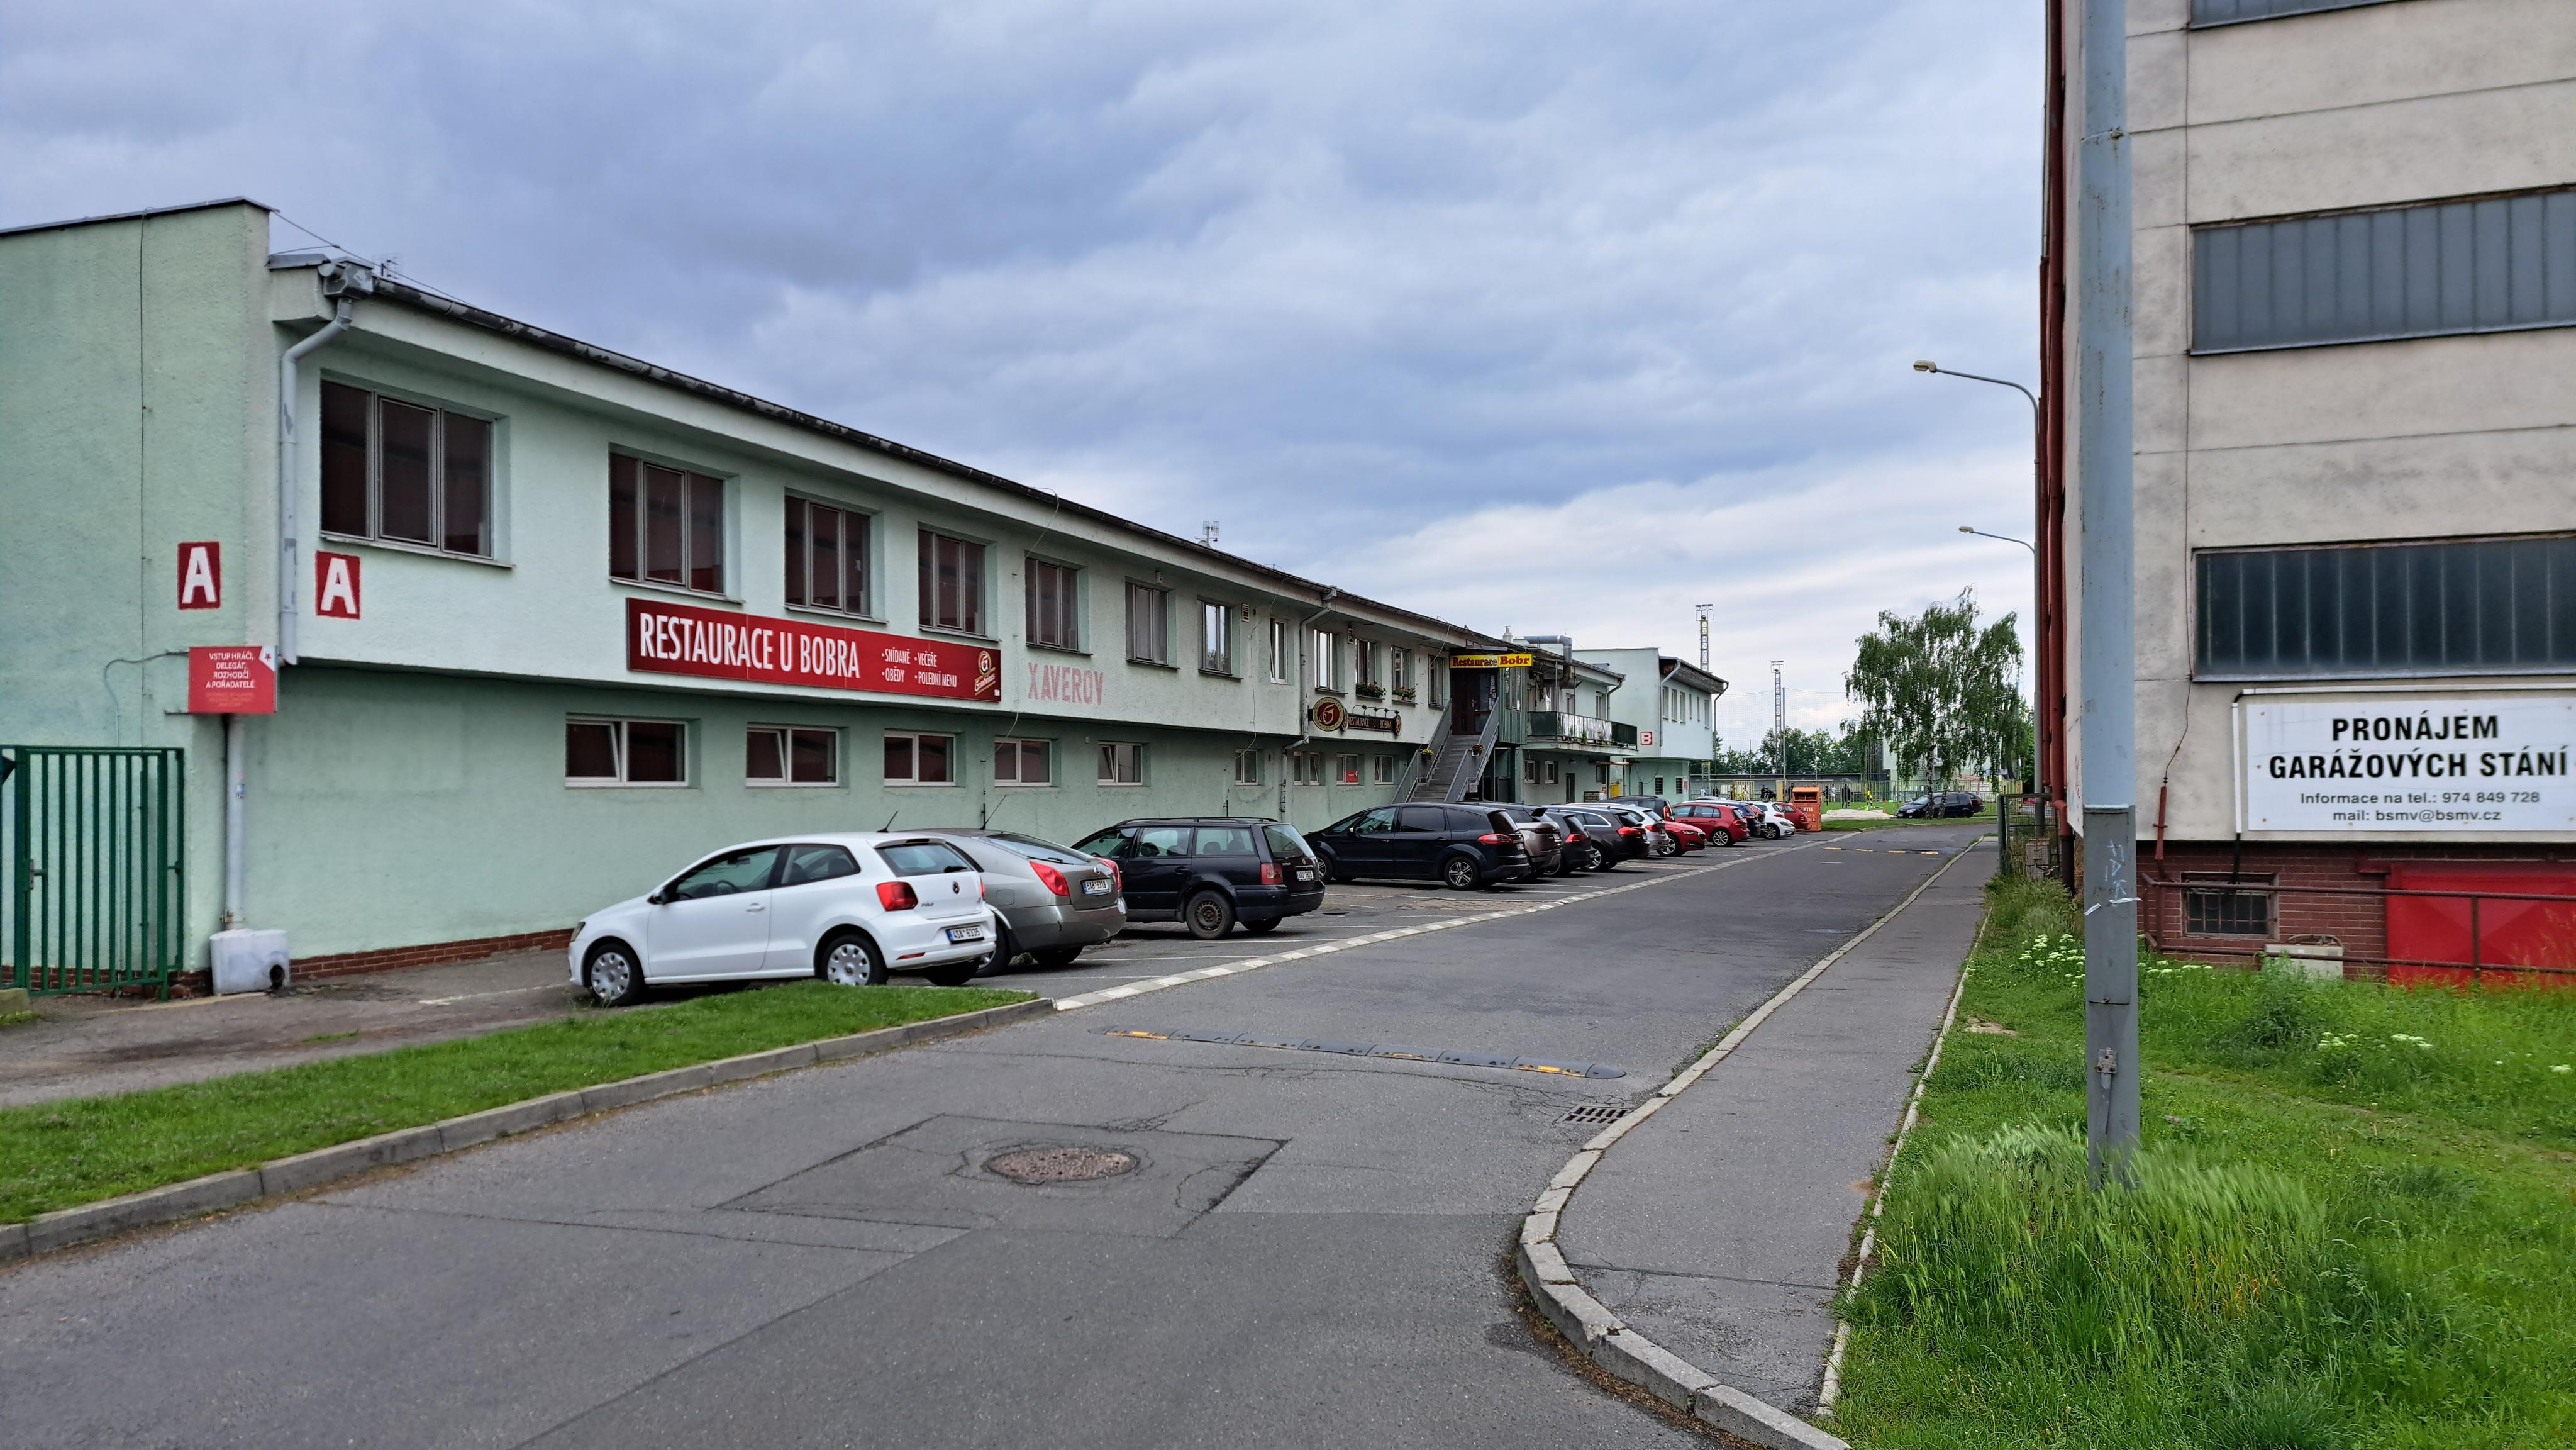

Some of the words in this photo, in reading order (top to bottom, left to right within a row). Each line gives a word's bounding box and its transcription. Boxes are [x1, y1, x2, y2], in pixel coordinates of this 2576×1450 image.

[182, 546, 217, 604] A
[321, 557, 358, 615] A
[640, 613, 774, 670] RESTAURACE
[780, 632, 792, 672] U
[800, 634, 860, 678] BOBRA
[885, 647, 910, 664] SNÍDANĚ
[918, 651, 937, 667] VEČEŘE
[1453, 657, 1497, 667] Restaurace
[1499, 655, 1530, 665] Bobr
[212, 679, 255, 688] POŘADATELÉ
[885, 666, 904, 683] OBĚDY
[918, 671, 941, 686] POLEDNÍ
[942, 674, 957, 688] MENU
[2333, 710, 2498, 742] PRONÁJEM
[1641, 732, 1652, 744] B
[2270, 748, 2466, 779] GARÁŽOVÝCH
[2480, 745, 2568, 777] STÁNÍ
[2301, 793, 2378, 804] Informace
[2384, 795, 2402, 804] na
[2407, 793, 2436, 803] tel.:
[2443, 792, 2470, 803] 974
[2477, 792, 2505, 803] 849
[2511, 791, 2540, 803] 728
[2333, 809, 2369, 821] mail:
[2376, 809, 2501, 822] bsmv@bsmv.cz
